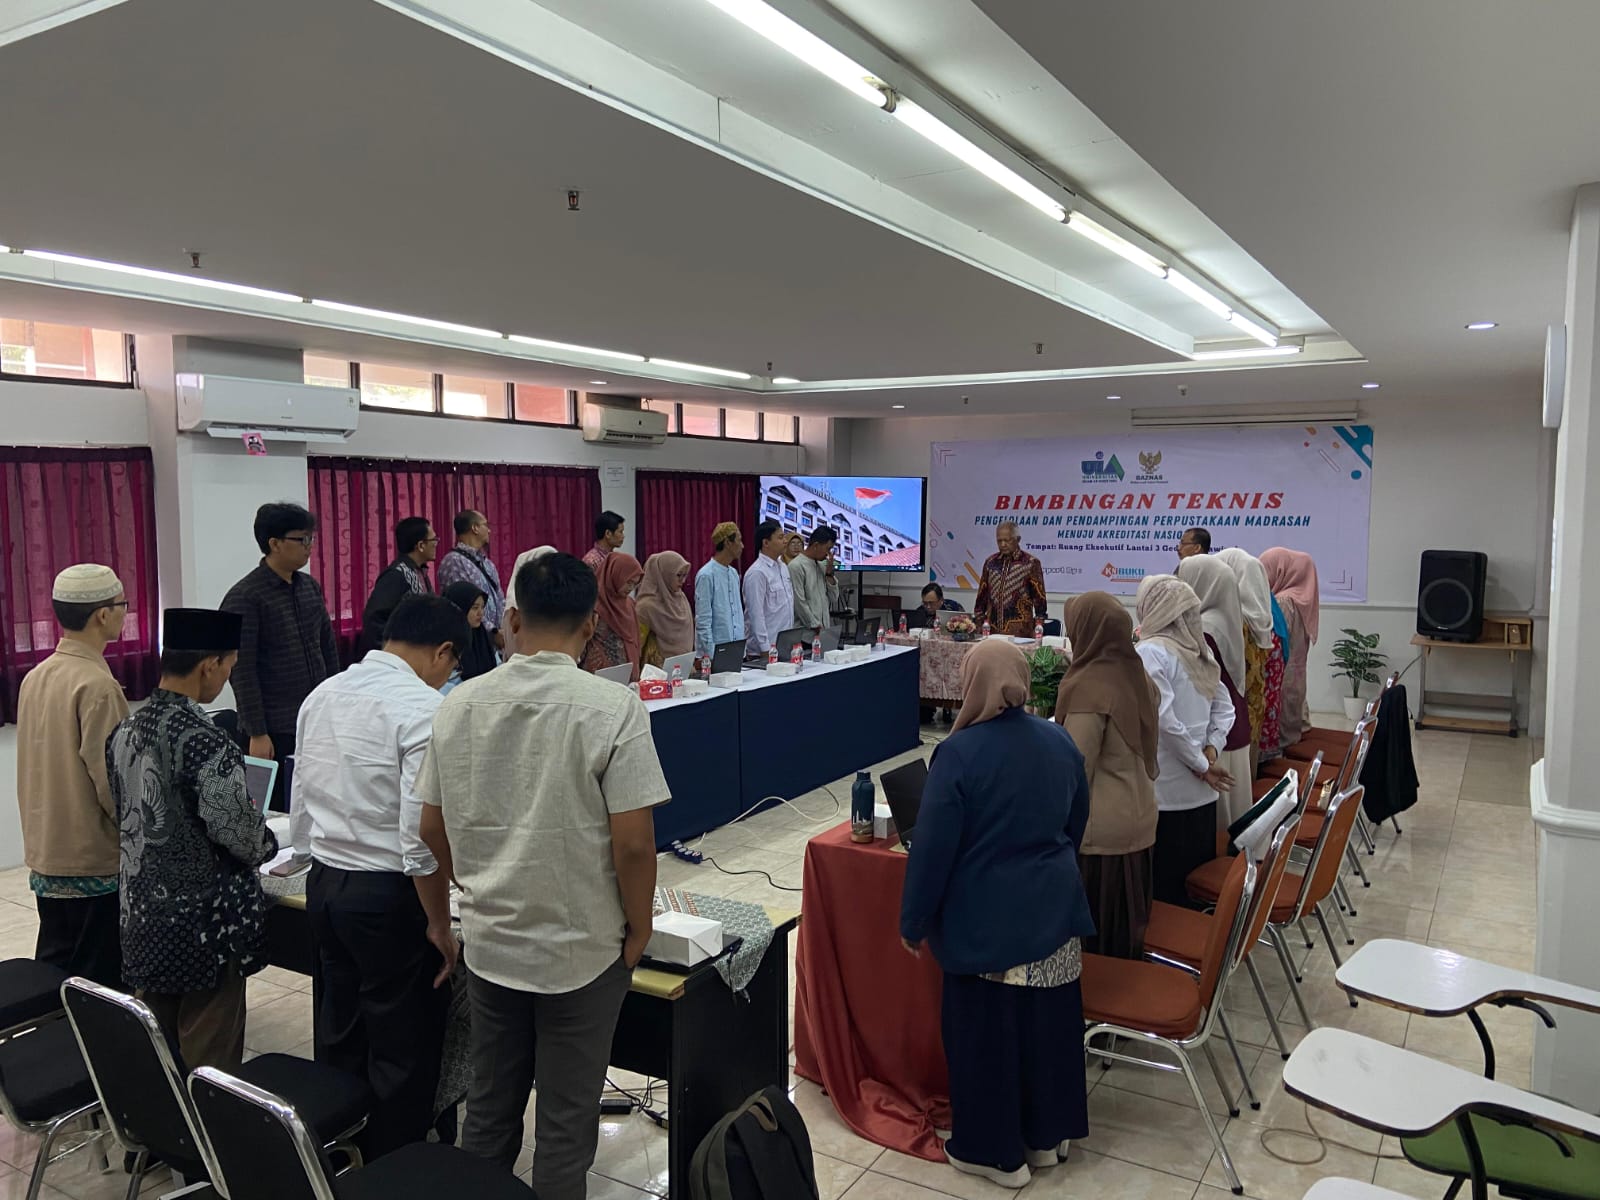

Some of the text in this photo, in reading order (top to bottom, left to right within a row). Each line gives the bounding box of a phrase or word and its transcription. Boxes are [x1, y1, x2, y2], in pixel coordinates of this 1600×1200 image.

[994, 492, 1285, 510] BIMBINGAN TEKNIS
[1042, 515, 1062, 526] DAN
[1066, 515, 1149, 526] PENDAMPINGAN
[1153, 515, 1240, 526] PERPUSTAKAAN
[1245, 515, 1310, 527] MADRASAH
[1057, 529, 1182, 540] MENUJU AKREDITASI NASIO
[1026, 543, 1057, 552] Tempat:
[1058, 543, 1083, 552] Ruang
[1086, 543, 1124, 552] Eksekutif
[1126, 543, 1153, 552] Lantai
